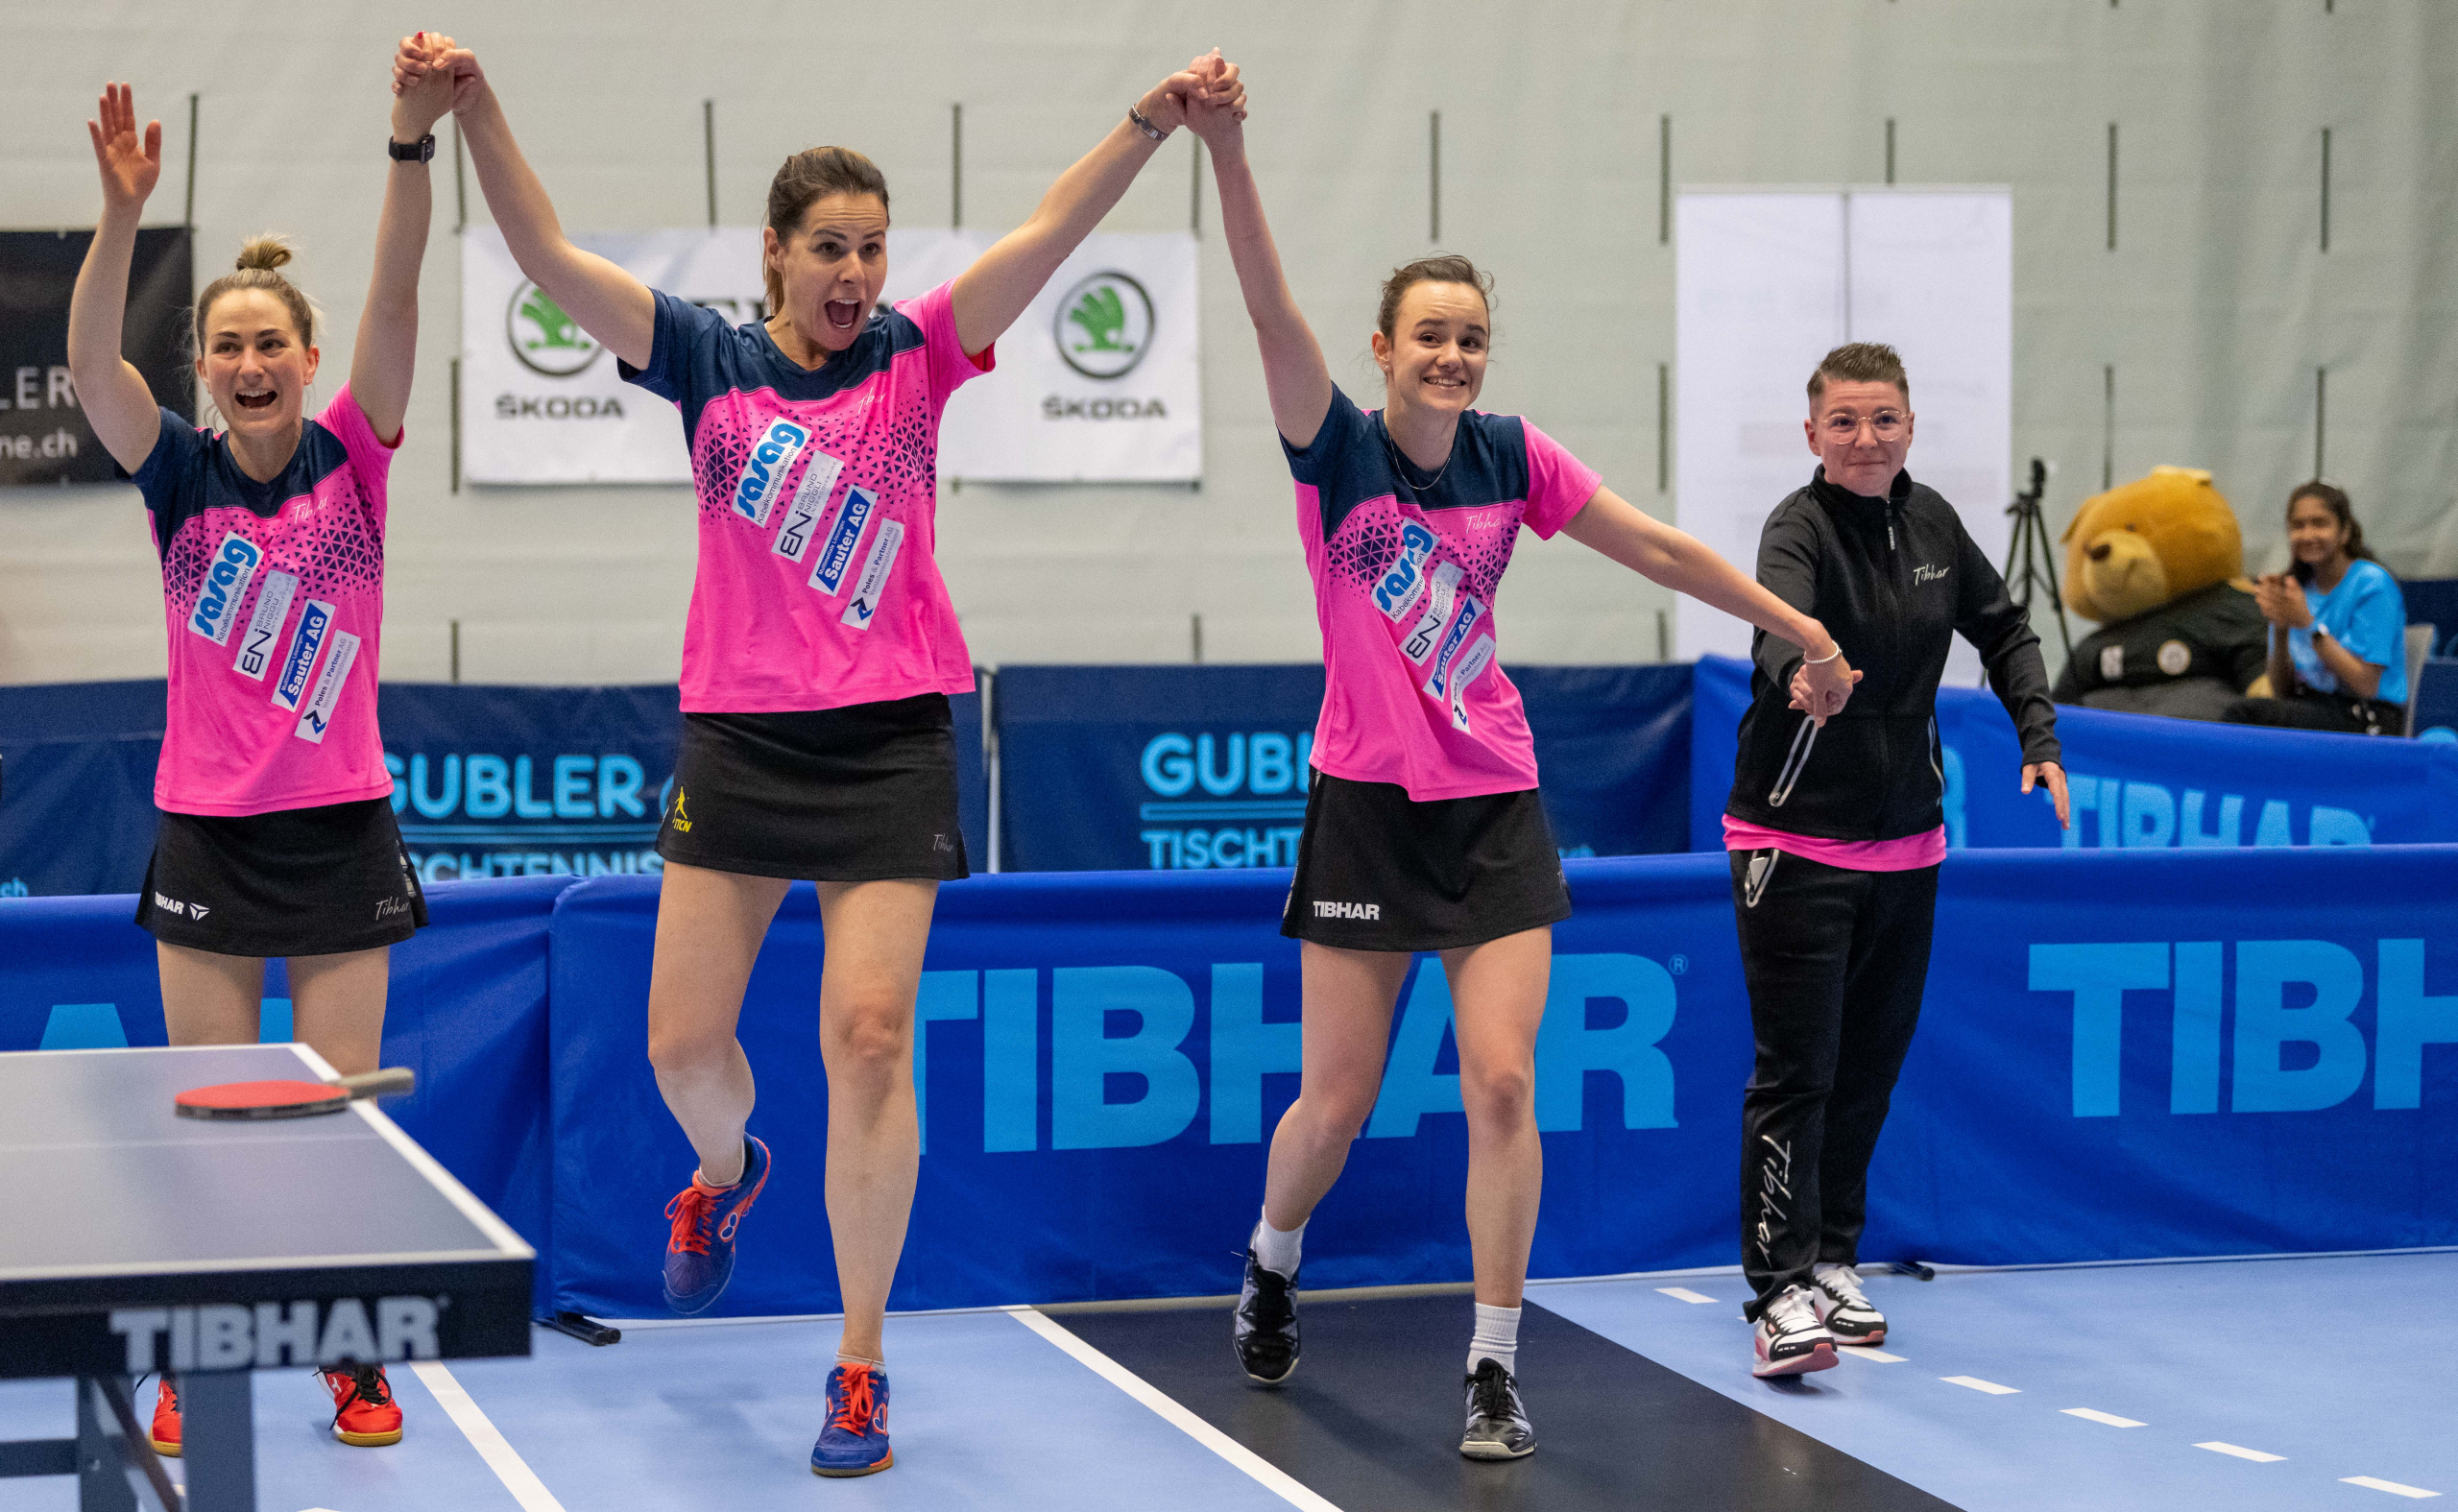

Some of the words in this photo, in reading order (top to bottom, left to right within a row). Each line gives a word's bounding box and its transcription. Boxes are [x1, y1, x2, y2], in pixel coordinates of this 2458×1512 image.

[737, 423, 805, 517] sasag
[293, 495, 328, 524] Tibar
[825, 527, 855, 581] Sauter
[848, 501, 866, 527] AG
[1466, 512, 1502, 534] Tibha
[195, 539, 257, 636] sasag
[862, 573, 874, 593] Poles
[874, 537, 889, 564] Partner
[885, 526, 893, 537] AG
[1914, 564, 1950, 586] Tibhar
[287, 641, 314, 695] Sauter
[305, 613, 324, 640] AG
[1456, 612, 1473, 635] AG
[315, 684, 326, 706] Poles
[326, 649, 341, 677] Partner
[338, 637, 346, 649] AG
[1460, 652, 1482, 675] Partner
[1313, 900, 1380, 921] TIBHAR
[1757, 1135, 1792, 1269] Tibhar
[109, 1295, 441, 1375] TIBHAR
